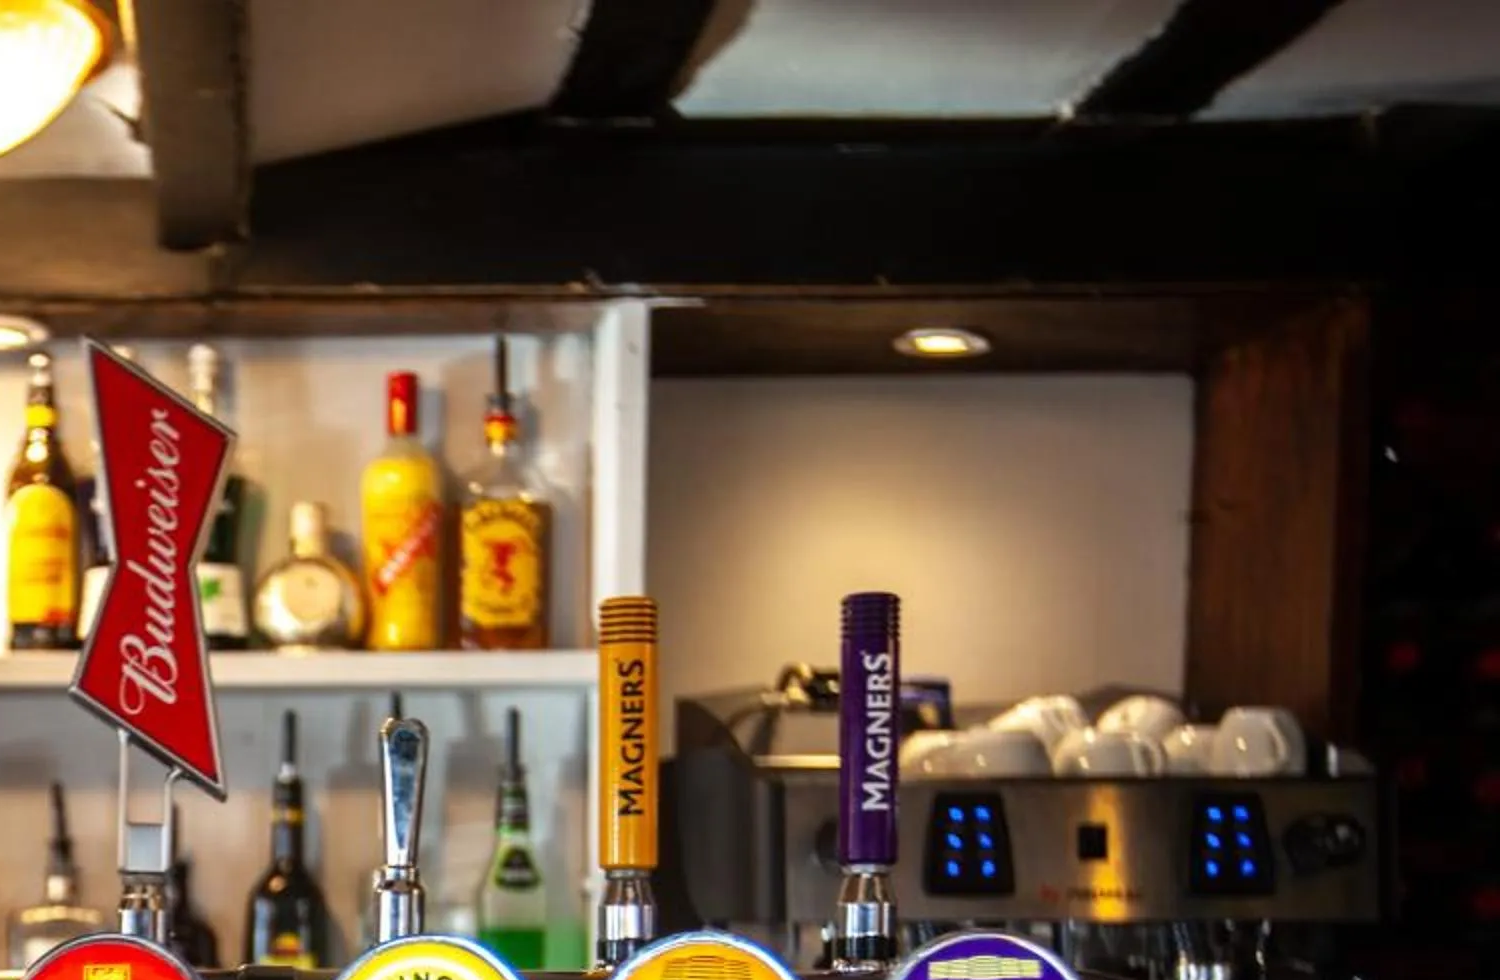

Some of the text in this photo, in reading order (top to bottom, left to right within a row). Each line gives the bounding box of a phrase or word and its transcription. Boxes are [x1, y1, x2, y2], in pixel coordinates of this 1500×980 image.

[119, 408, 183, 716] Budweiser
[617, 658, 646, 818] MAGNERS
[861, 652, 892, 811] MAGNERS
